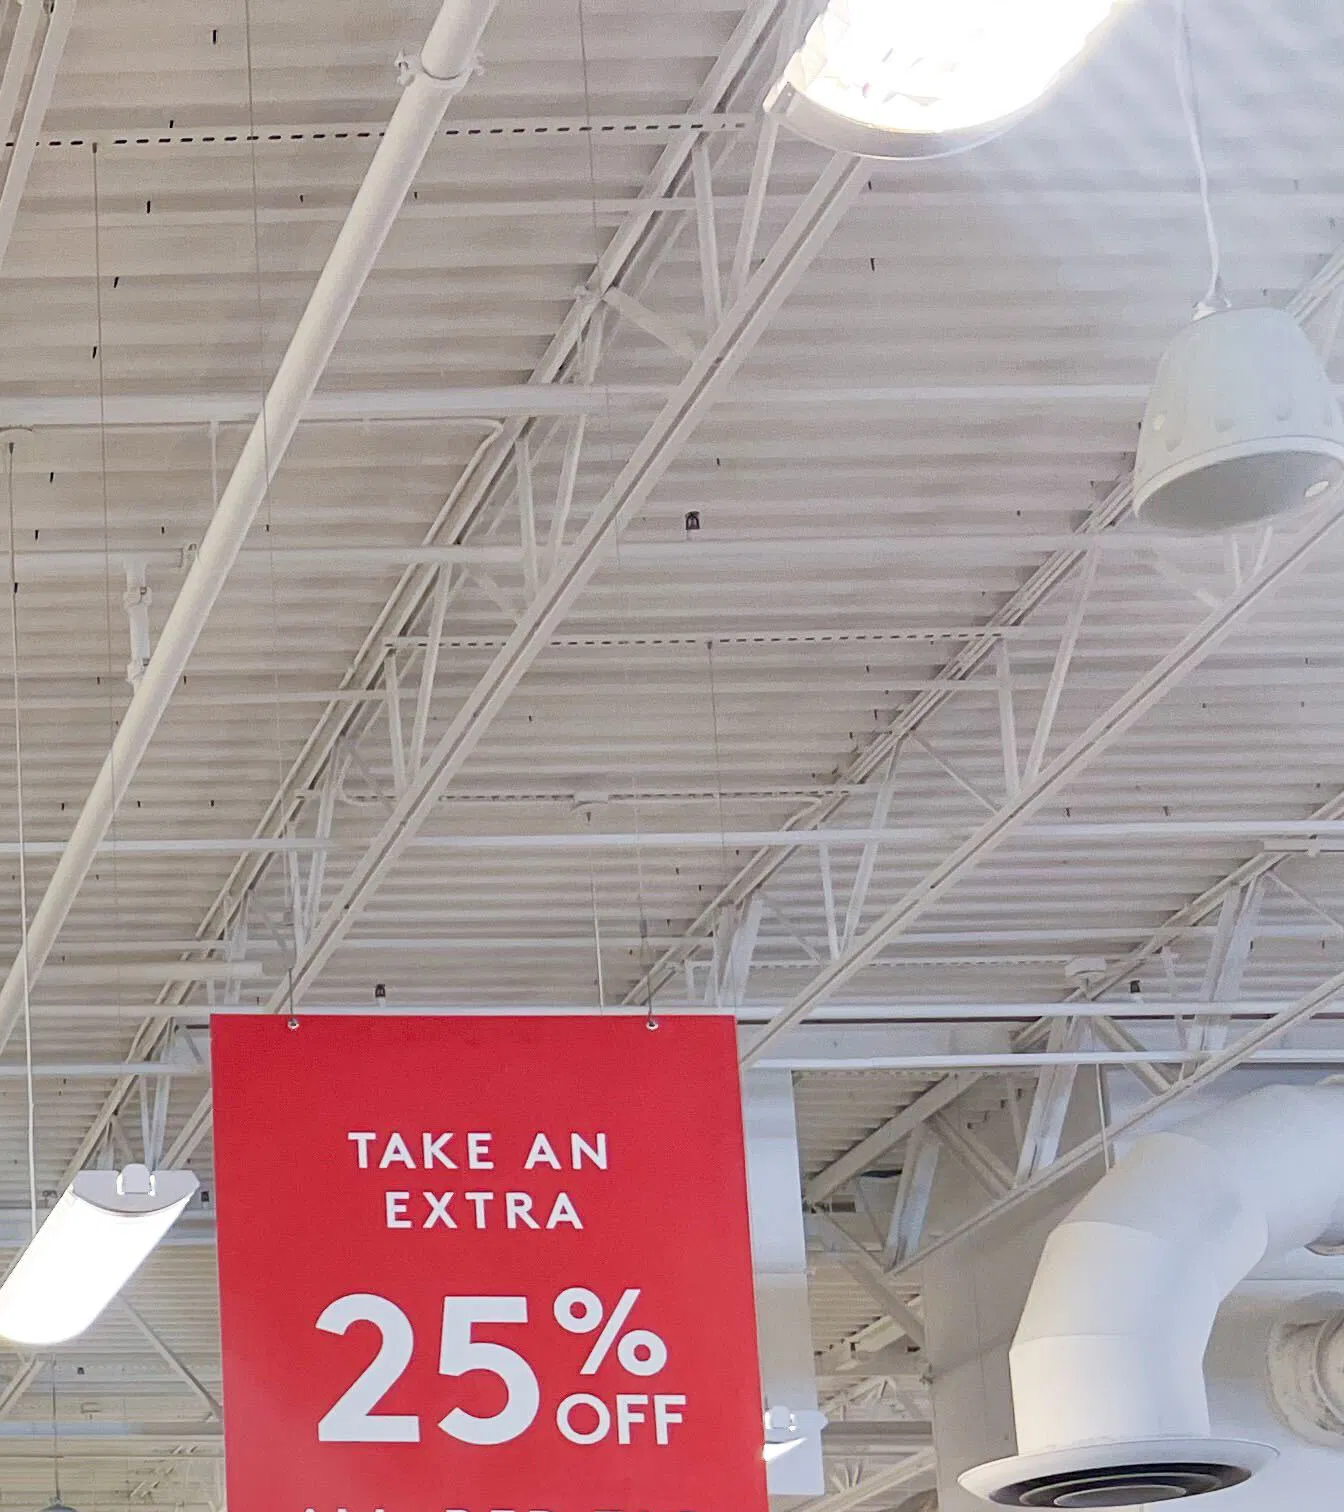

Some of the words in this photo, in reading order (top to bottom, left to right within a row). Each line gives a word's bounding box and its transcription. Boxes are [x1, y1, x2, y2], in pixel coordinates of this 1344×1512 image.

[348, 1132, 494, 1169] TAKE
[524, 1132, 608, 1169] AN
[386, 1191, 584, 1229] EXTRA
[557, 1394, 687, 1445] OFF
